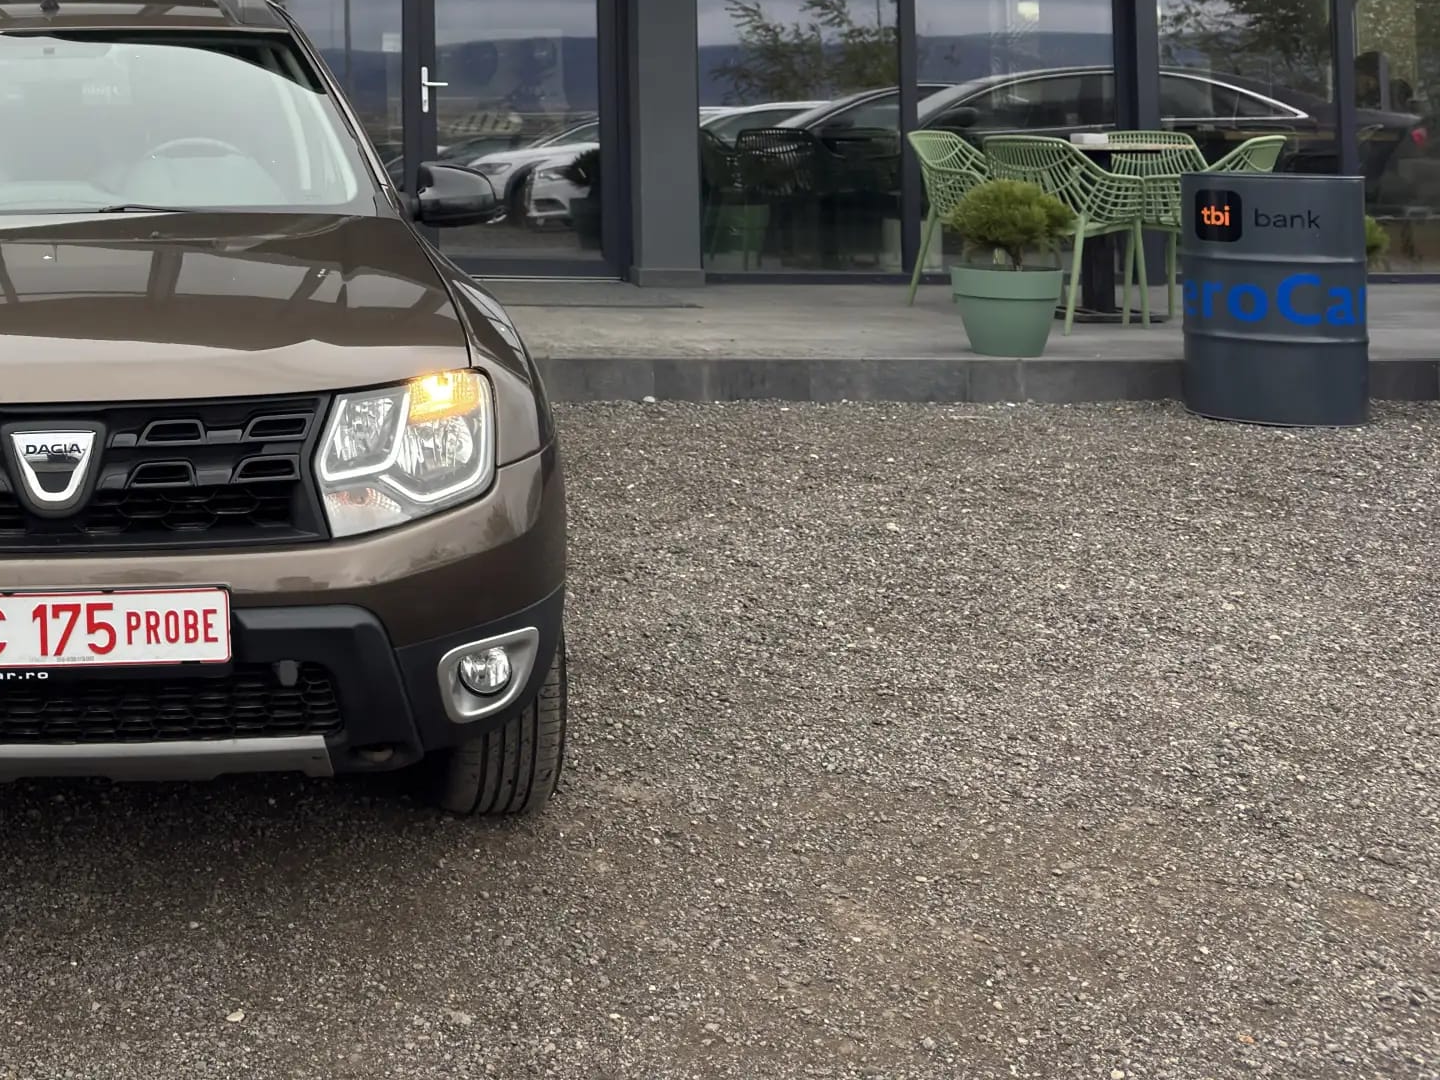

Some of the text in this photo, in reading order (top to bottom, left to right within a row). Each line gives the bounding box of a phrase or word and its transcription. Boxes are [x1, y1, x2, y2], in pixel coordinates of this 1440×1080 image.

[1201, 205, 1321, 229] tbi bank
[25, 443, 82, 455] DACIA
[31, 603, 117, 657] 175
[126, 608, 219, 646] PROBE
